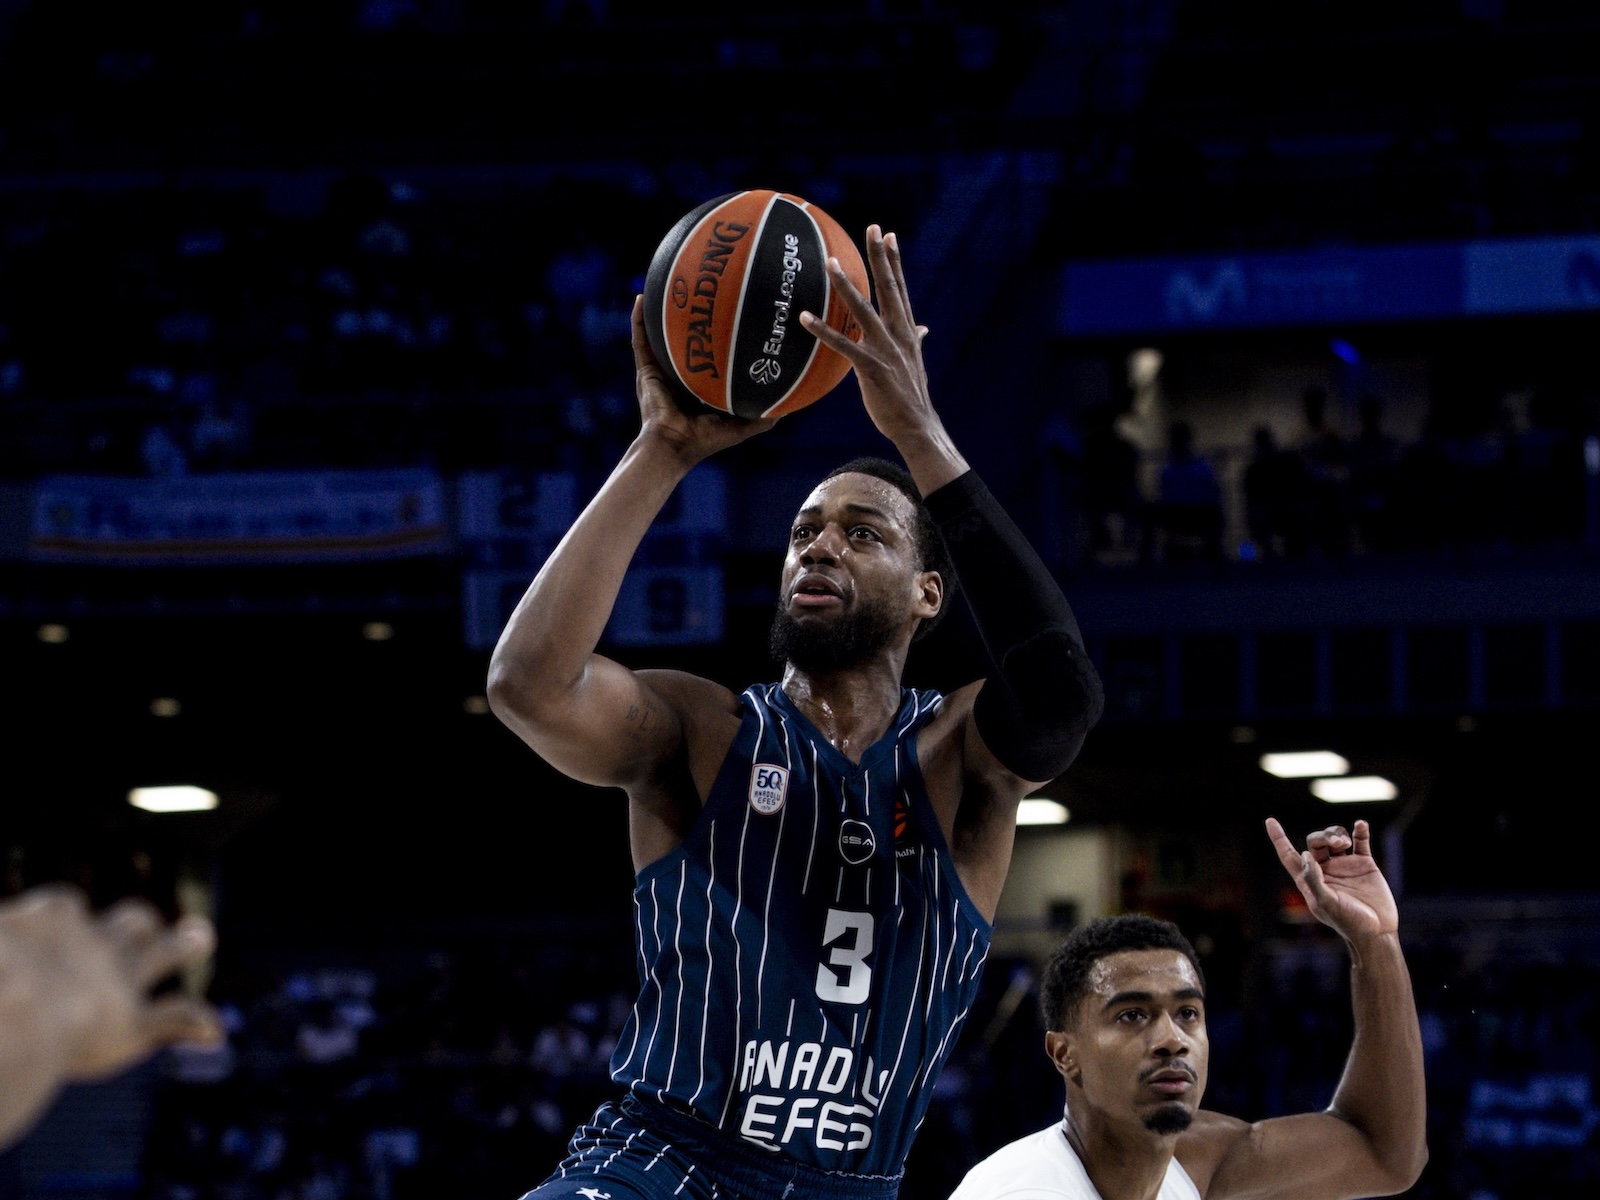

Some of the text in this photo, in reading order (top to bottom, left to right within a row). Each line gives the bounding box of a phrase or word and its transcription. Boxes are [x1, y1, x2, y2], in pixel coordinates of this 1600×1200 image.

[685, 219, 750, 379] SPALDING
[763, 232, 803, 356] EuroLeague
[754, 790, 781, 801] ANADOLU
[756, 769, 783, 791] 50
[757, 797, 777, 806] EFES
[841, 835, 874, 846] GSA
[815, 908, 874, 1005] 3
[740, 1094, 875, 1151] EFES
